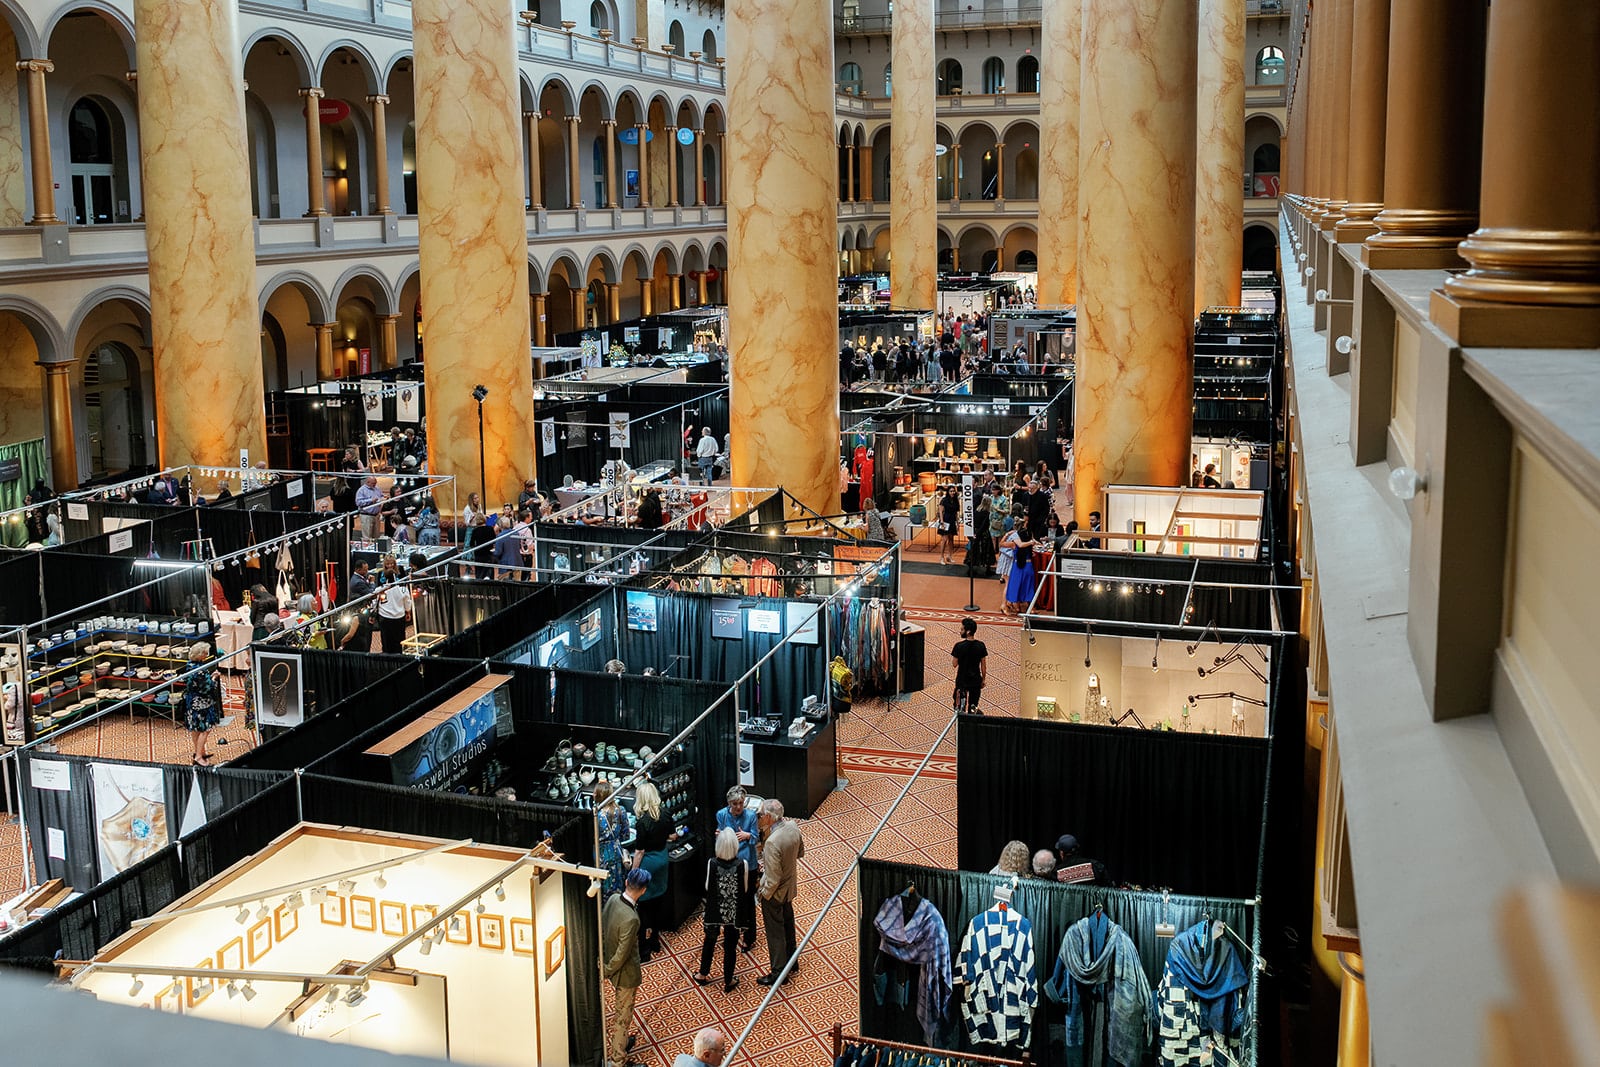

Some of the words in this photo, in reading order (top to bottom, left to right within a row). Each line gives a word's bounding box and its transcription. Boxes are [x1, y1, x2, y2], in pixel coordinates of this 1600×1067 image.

[964, 484, 972, 502] 100
[965, 505, 973, 528] Aisle
[1025, 660, 1062, 672] ROBERT
[1025, 671, 1068, 682] FARRELL
[452, 738, 488, 771] Studios
